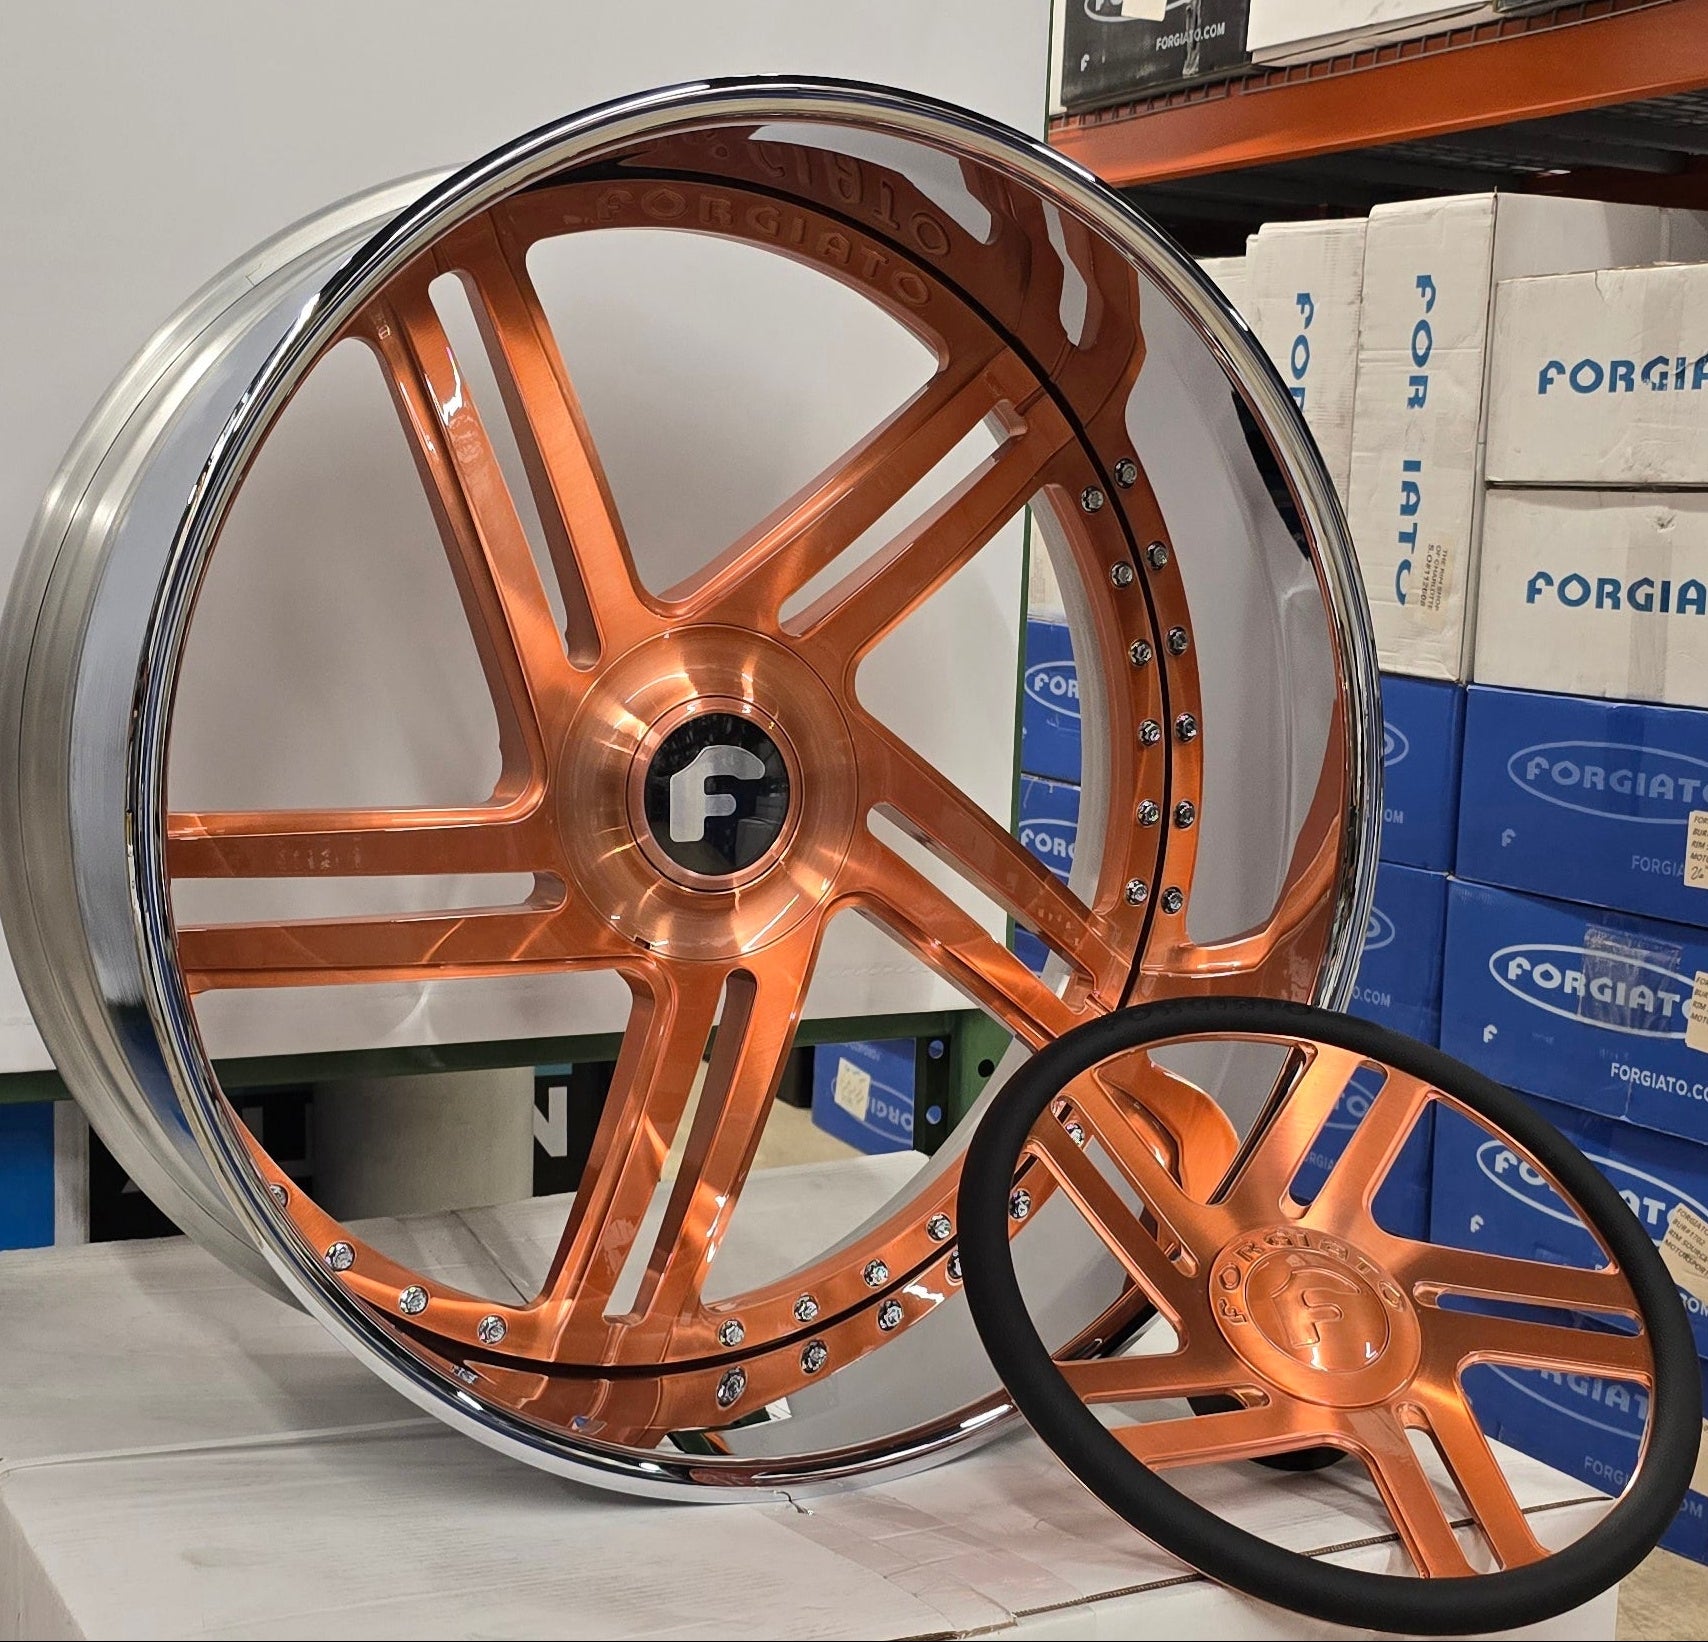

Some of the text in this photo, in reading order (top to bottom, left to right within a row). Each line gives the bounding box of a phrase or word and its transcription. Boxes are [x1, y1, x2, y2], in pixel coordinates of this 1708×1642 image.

[1156, 22, 1225, 51] FORGIATO.COM
[596, 187, 932, 305] FORGIATO
[1526, 571, 1707, 615] FORGIA
[1526, 756, 1708, 803] FORGIAT
[1217, 1230, 1404, 1325] FORGIATO
